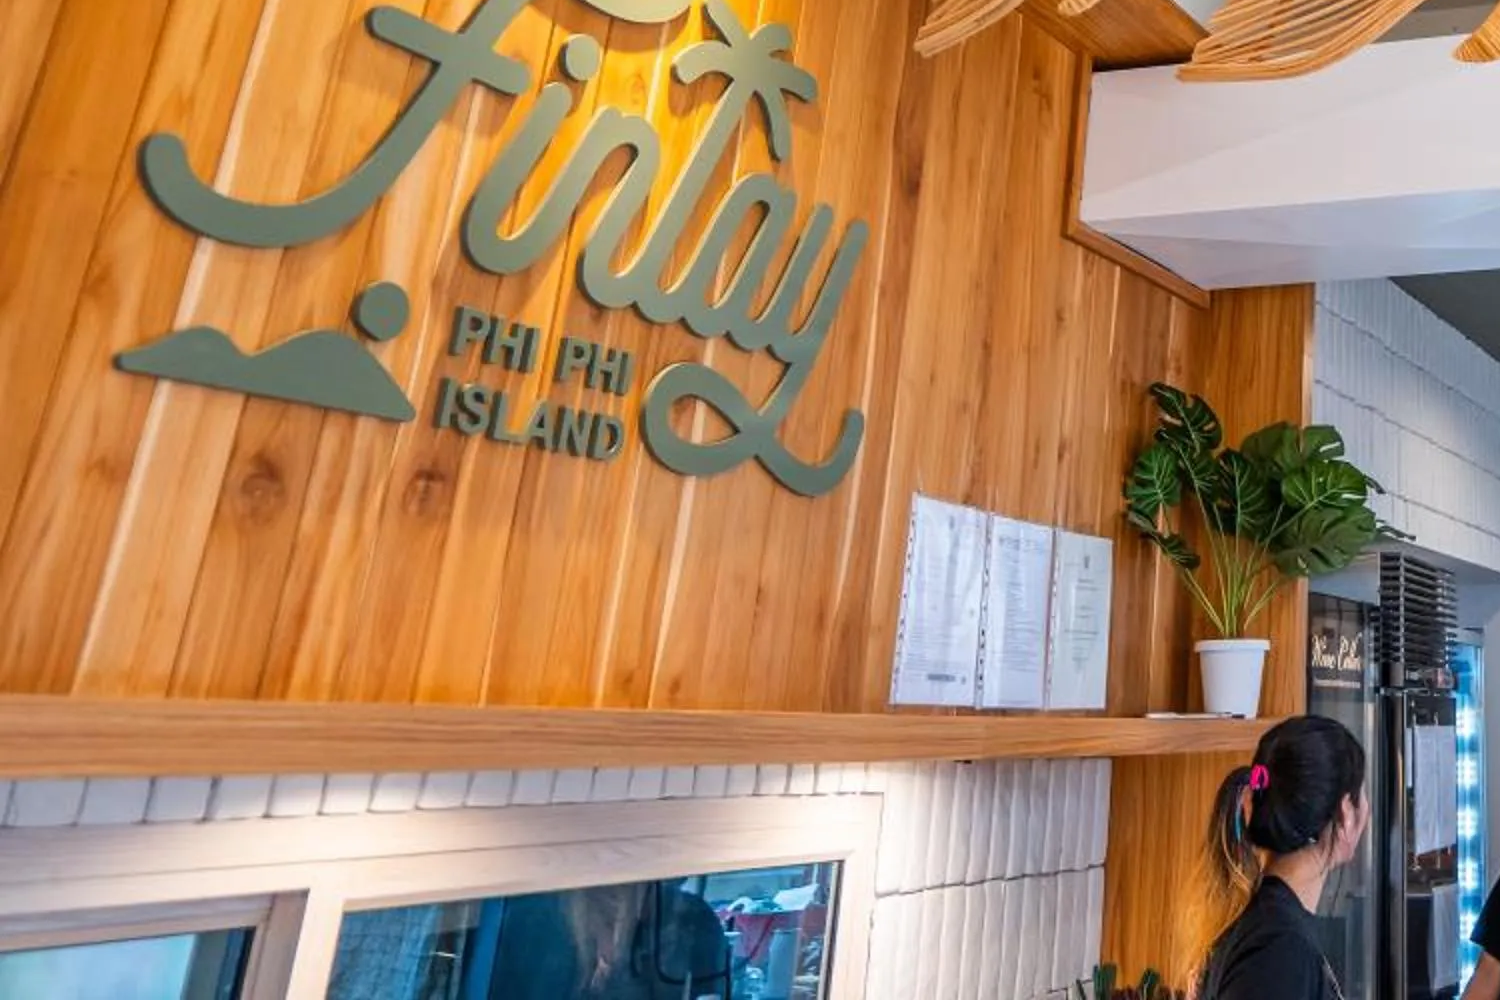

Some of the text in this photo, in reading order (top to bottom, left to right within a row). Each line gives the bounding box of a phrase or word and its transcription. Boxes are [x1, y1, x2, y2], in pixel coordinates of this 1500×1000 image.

[448, 305, 633, 396] PHI PHI
[434, 377, 624, 461] ISLAND
